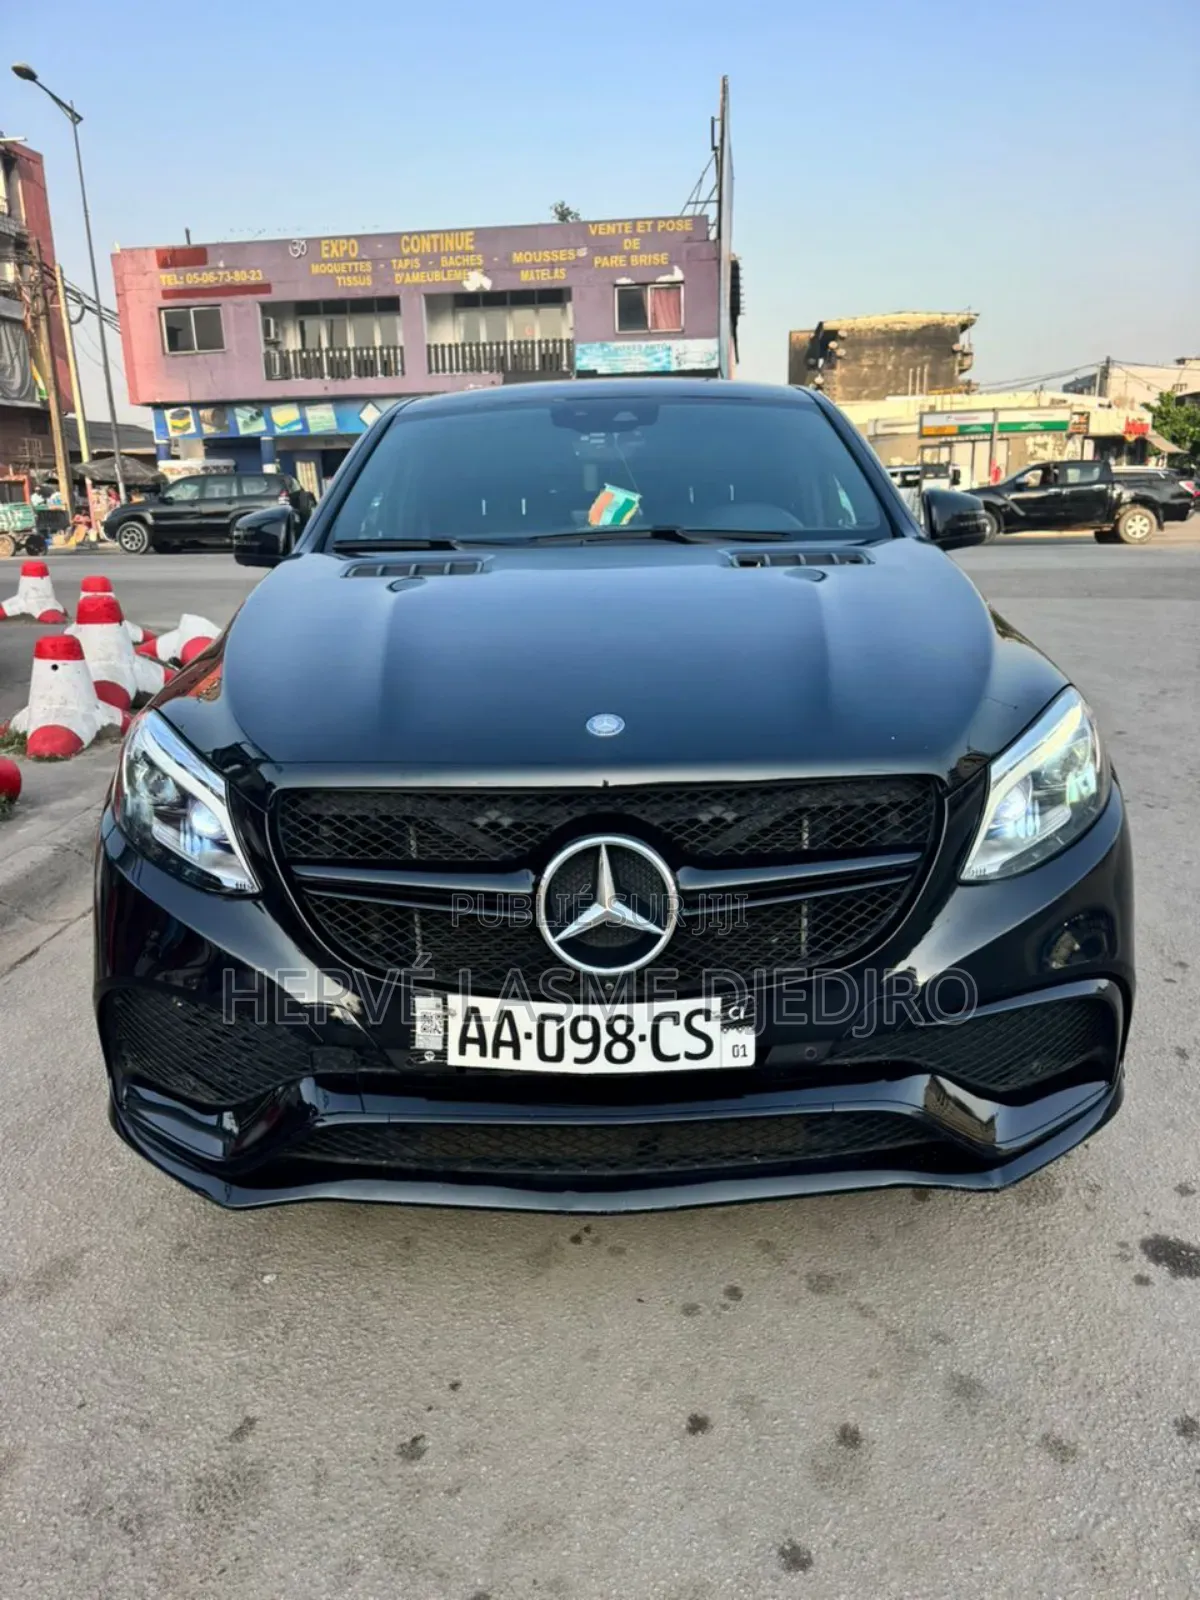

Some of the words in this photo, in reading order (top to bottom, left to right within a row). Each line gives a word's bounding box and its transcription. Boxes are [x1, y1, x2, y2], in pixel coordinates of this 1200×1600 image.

[589, 222, 633, 236] VENTE
[636, 220, 654, 234] ET
[657, 219, 694, 232] POSE
[320, 239, 359, 260] EXPO
[400, 231, 475, 255] CONTINUE
[623, 238, 641, 251] DE
[311, 261, 372, 275] MOQUETTES
[391, 258, 421, 271] TAPIS
[440, 254, 485, 269] BACHES
[512, 249, 576, 264] MOUSSES
[594, 254, 627, 268] PARE
[630, 252, 669, 266] BRISE
[336, 275, 372, 288] TISSUS
[394, 269, 484, 284] D'AMEUBLEME
[520, 268, 566, 282] MATELAS
[731, 1044, 748, 1058] 01
